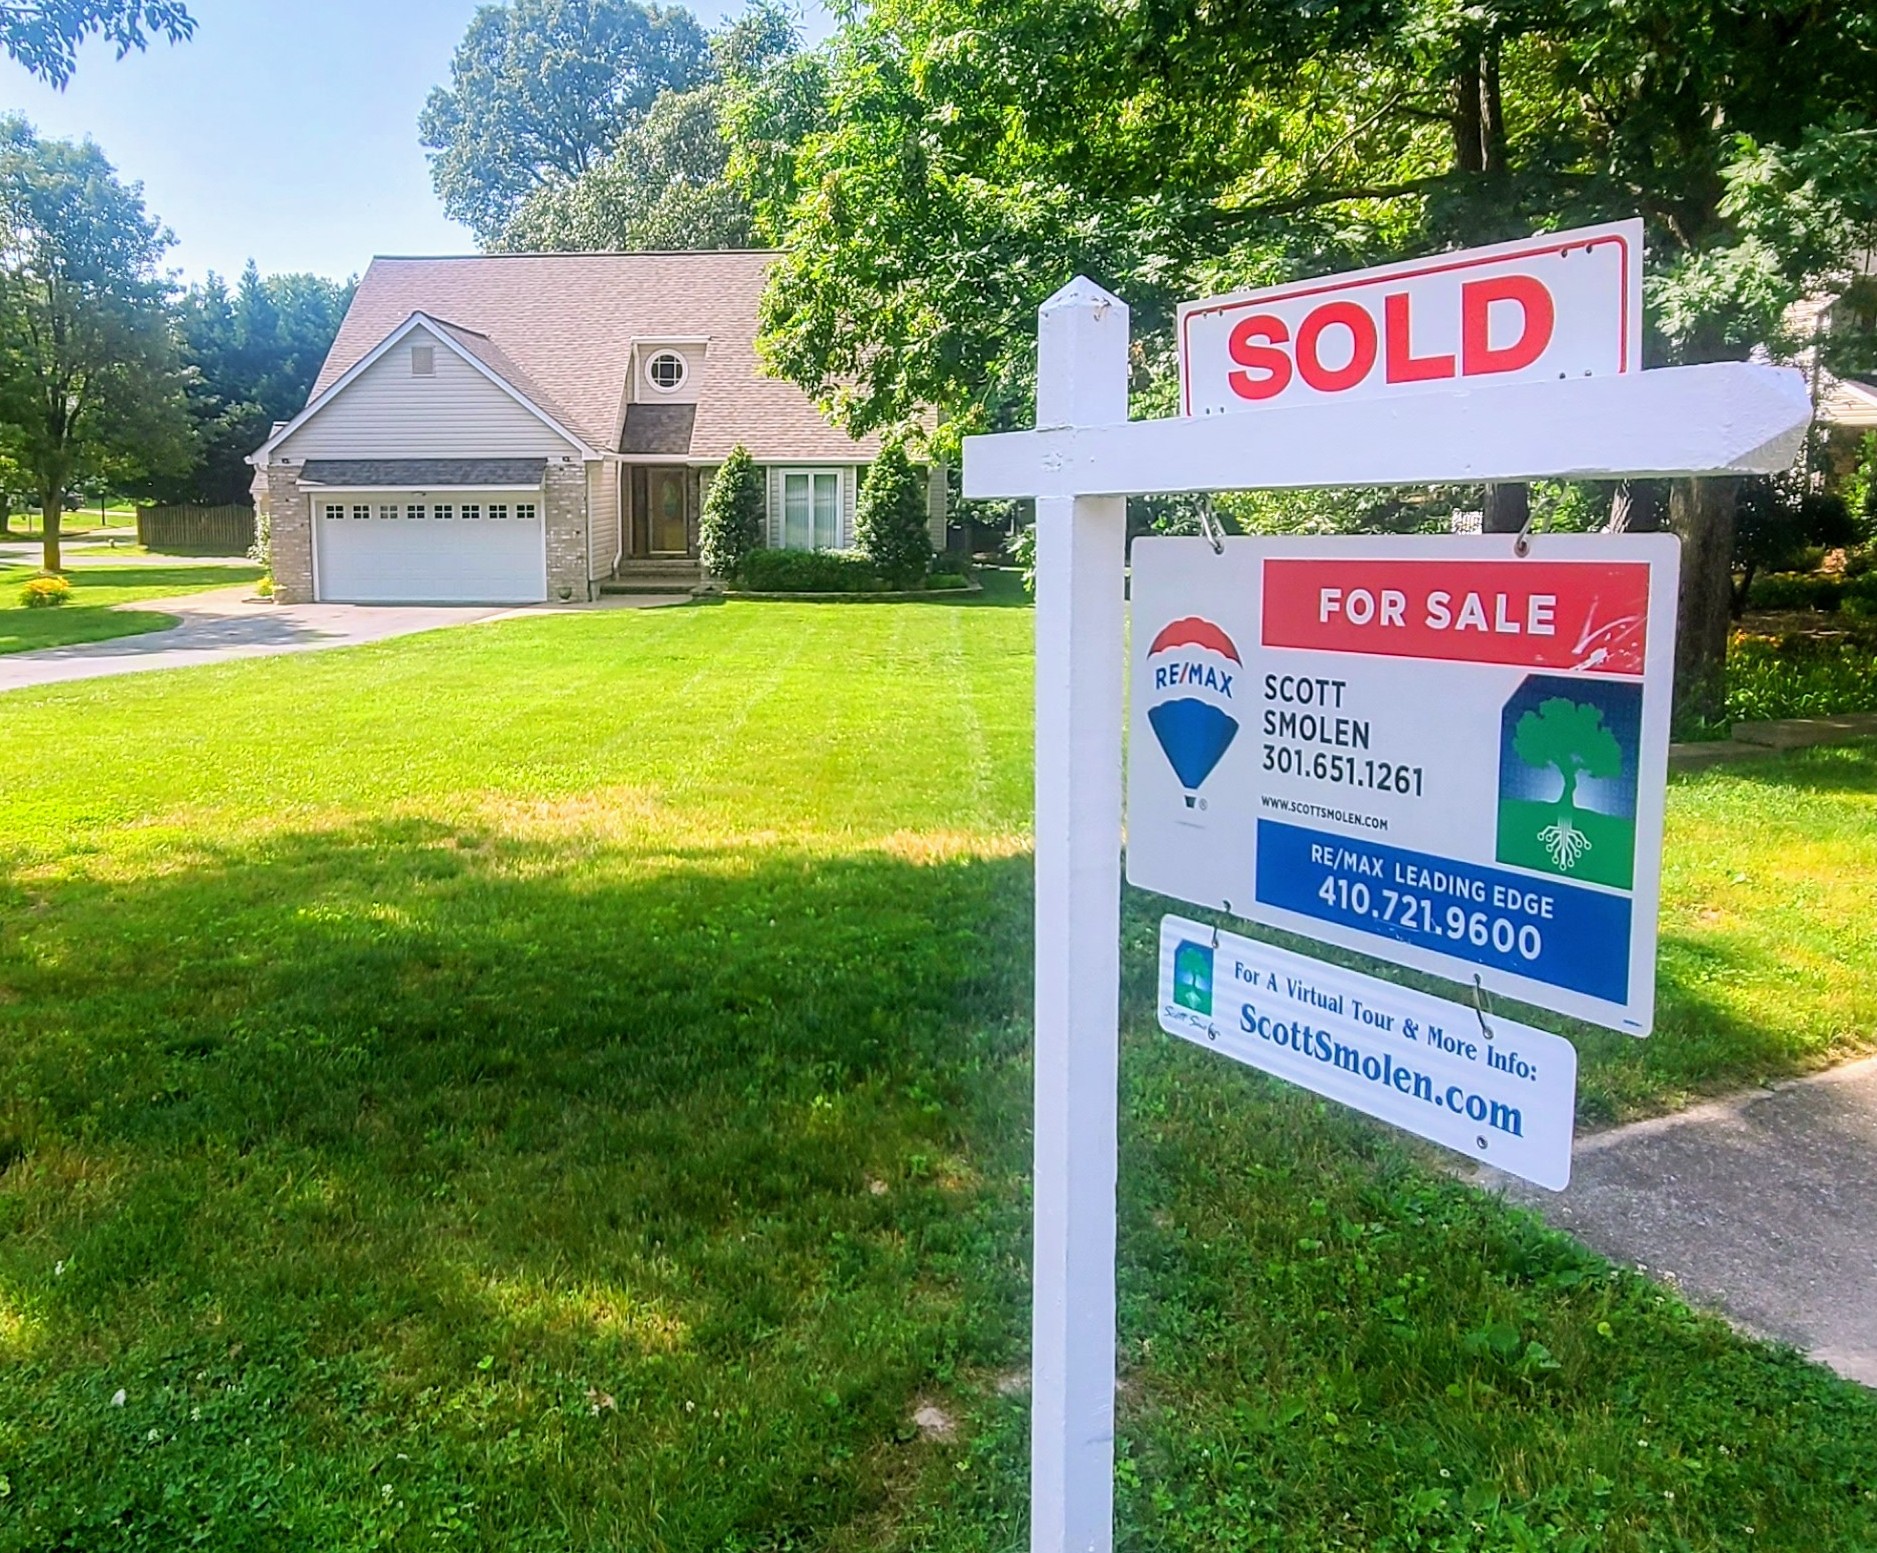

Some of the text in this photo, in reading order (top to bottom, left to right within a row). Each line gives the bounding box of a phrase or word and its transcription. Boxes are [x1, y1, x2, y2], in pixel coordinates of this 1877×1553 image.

[1228, 274, 1554, 400] SOLD
[1319, 588, 1556, 635] FOR SALE
[1156, 662, 1233, 699] RE/MAX
[1264, 674, 1346, 708] SCOTT
[1263, 709, 1369, 750] SMOLEN
[1263, 744, 1422, 797] 301.651.1261
[1261, 796, 1388, 830] WWW.SCOTTSMOLEN.COM
[1311, 844, 1554, 919] RE/MAX LEADING EDGE
[1318, 876, 1542, 960] 410.721.9600
[1235, 961, 1536, 1081] For A Virtual Tour & More Info:
[1240, 1003, 1523, 1138] ScottSmolen.com
